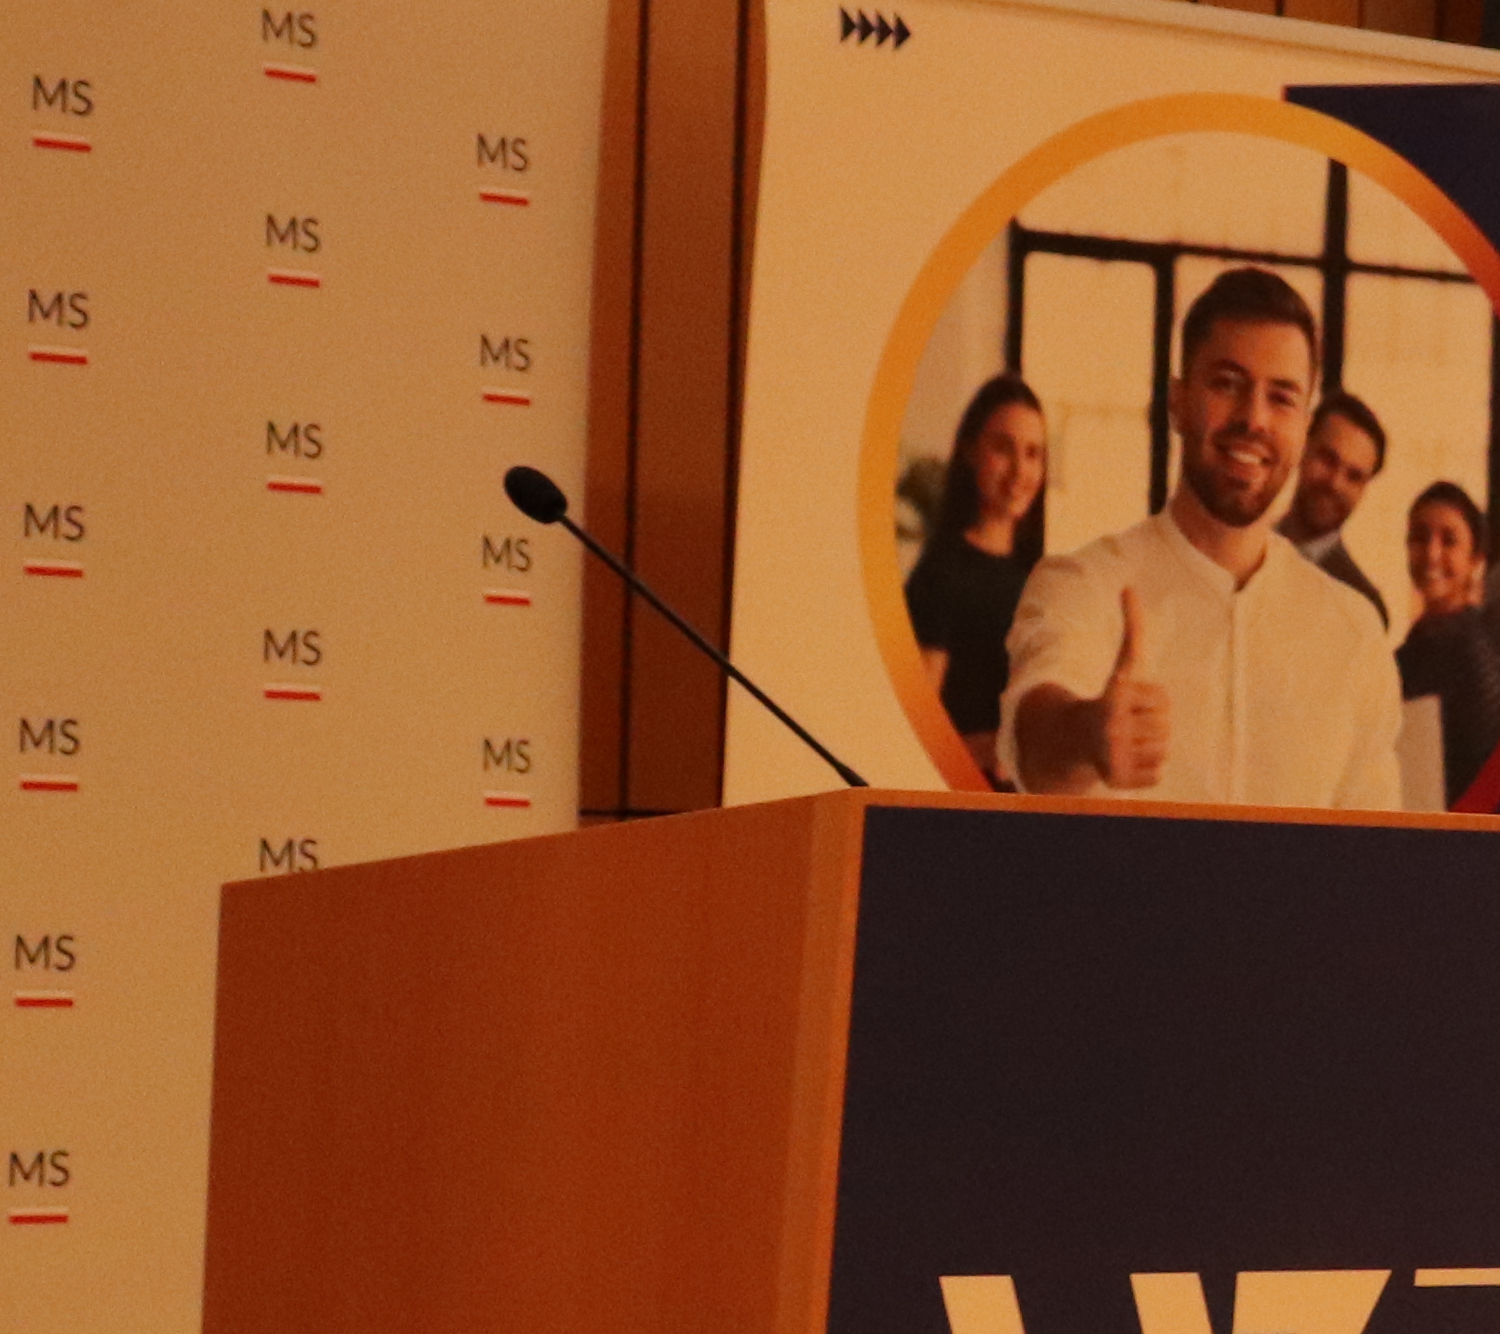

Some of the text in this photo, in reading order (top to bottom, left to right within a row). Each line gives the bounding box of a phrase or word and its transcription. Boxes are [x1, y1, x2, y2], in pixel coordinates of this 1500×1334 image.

[261, 8, 317, 49] MS
[32, 74, 93, 117] MS
[477, 133, 529, 173] MS
[266, 213, 321, 254] MS
[28, 289, 89, 330] MS
[480, 334, 531, 373] MS
[266, 421, 323, 460] MS
[24, 503, 85, 542] MS
[482, 535, 532, 573] MS
[263, 629, 322, 667] MS
[20, 718, 80, 756] MS
[483, 738, 531, 775] MS
[15, 934, 76, 972] MS
[9, 1150, 70, 1188] MS
